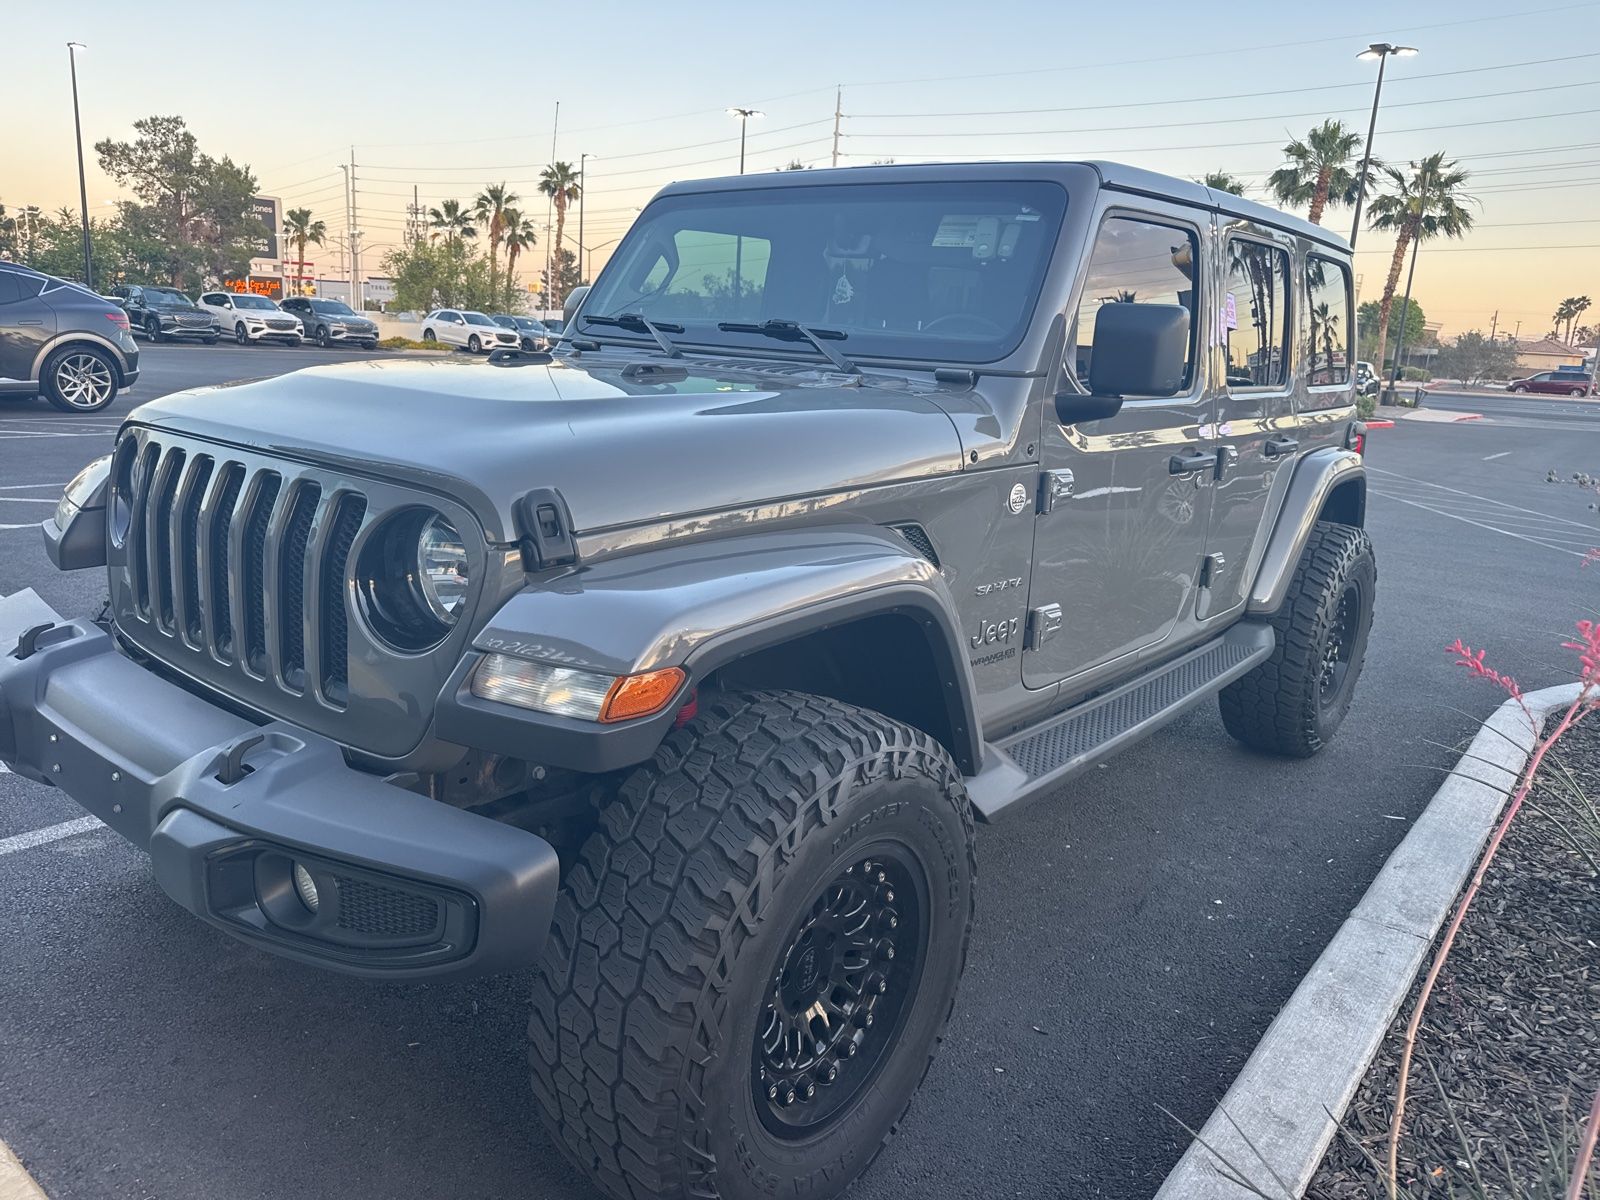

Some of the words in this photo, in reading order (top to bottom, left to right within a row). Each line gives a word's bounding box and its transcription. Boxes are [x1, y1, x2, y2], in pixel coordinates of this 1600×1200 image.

[252, 204, 273, 214] Jones
[976, 577, 1022, 597] SAHARA
[970, 617, 1019, 650] Jeep
[970, 647, 1016, 667] WRANGLER
